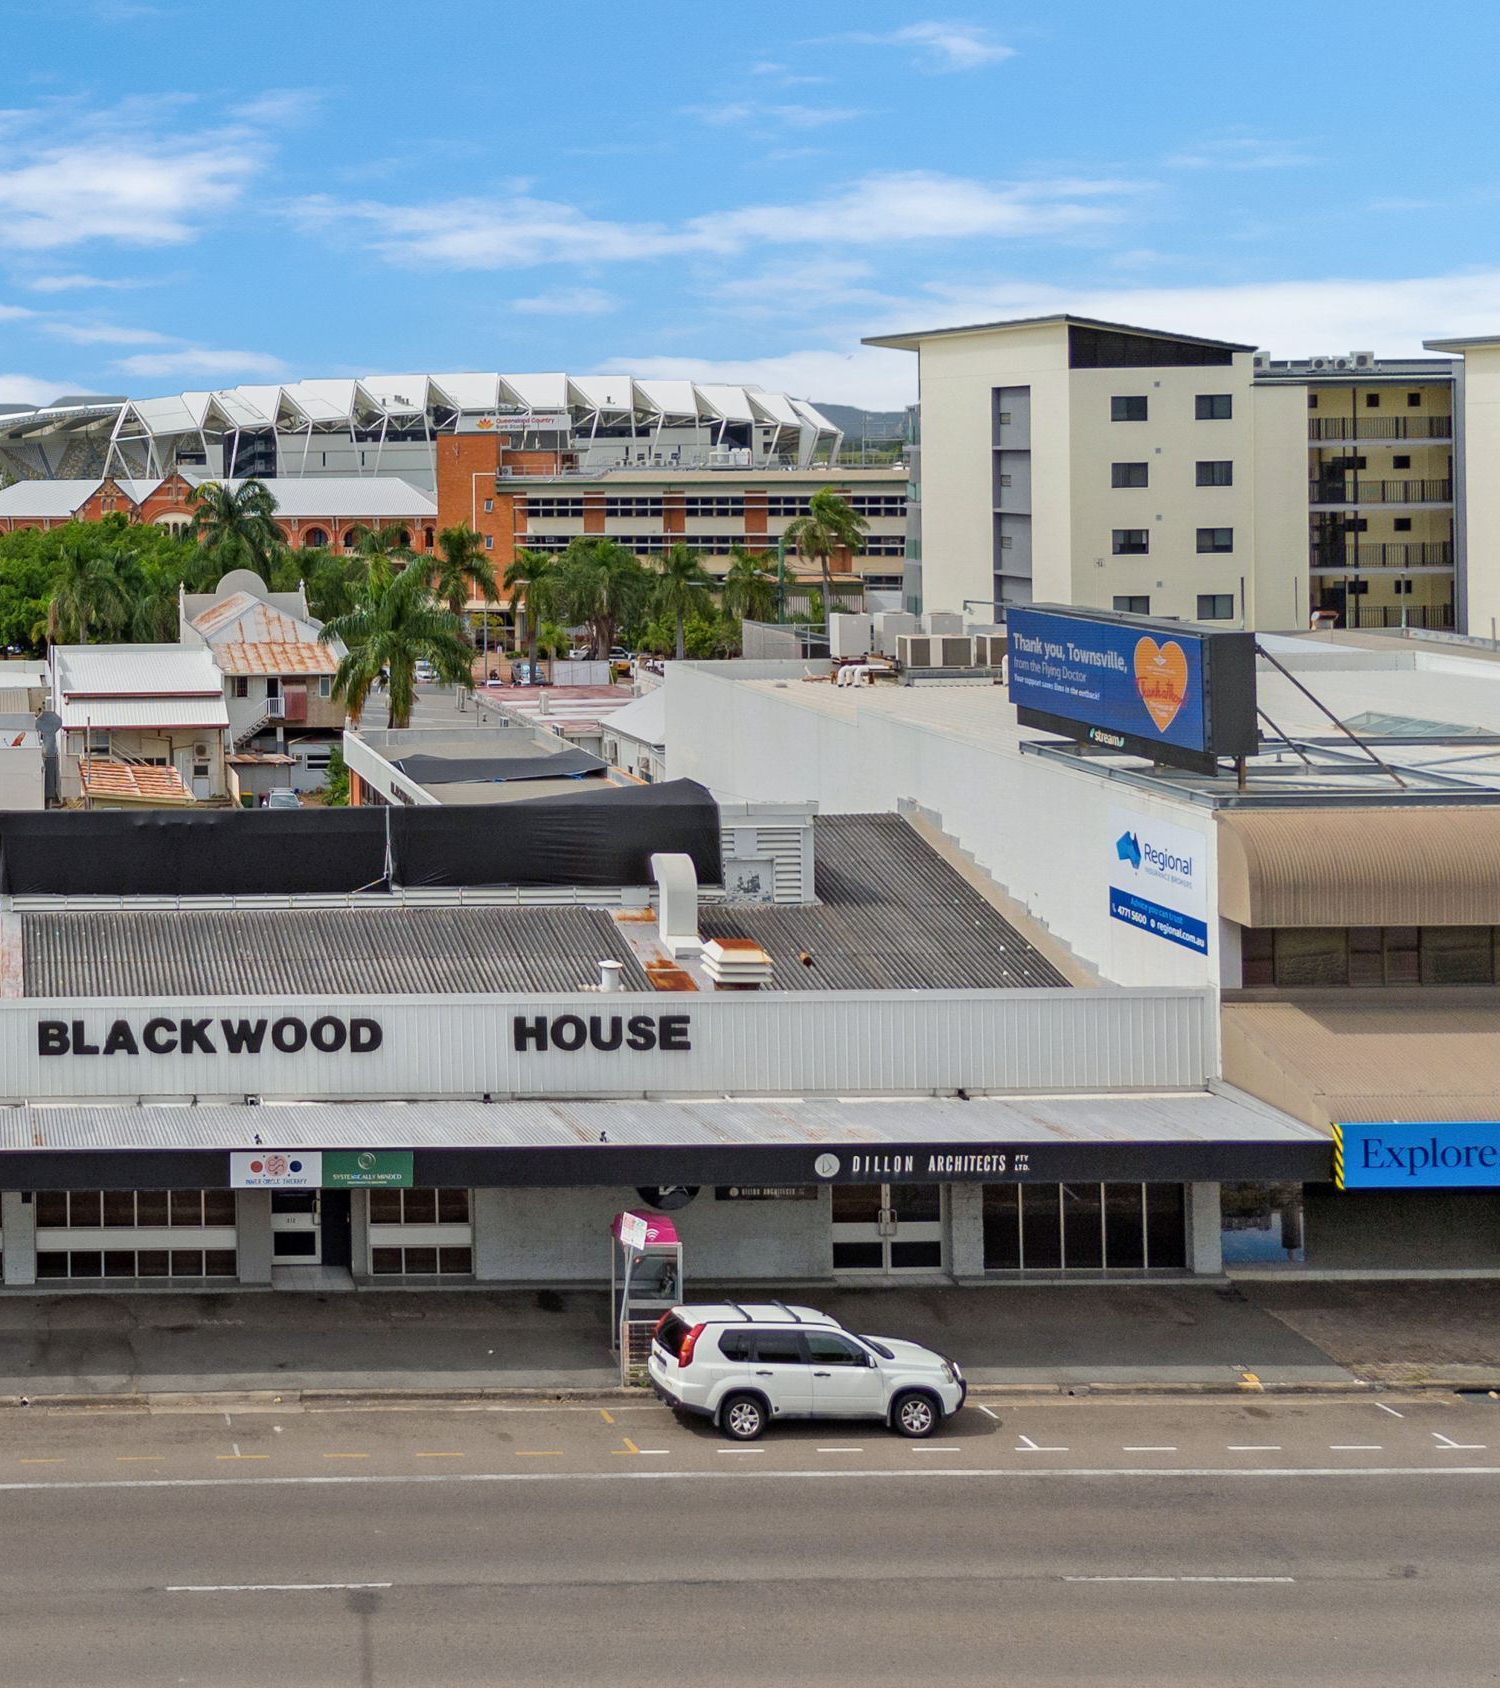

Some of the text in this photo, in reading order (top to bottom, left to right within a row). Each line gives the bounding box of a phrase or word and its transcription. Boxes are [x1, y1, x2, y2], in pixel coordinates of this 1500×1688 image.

[531, 417, 555, 425] Country
[1013, 632, 1042, 655] Thank
[1044, 642, 1066, 661] you,
[1067, 643, 1128, 674] Townsville,
[1013, 656, 1087, 683] from the Flying Doctor
[1094, 729, 1120, 747] stream
[1144, 843, 1192, 876] Regional
[1118, 905, 1205, 948] 4771 5600 regional.com.au
[1148, 905, 1159, 914] you
[1159, 909, 1169, 918] can
[38, 1014, 692, 1056] BLACKWOOD HOUSE
[852, 1155, 1006, 1172] DILLON ARCHITECTS
[1361, 1137, 1497, 1176] Explore
